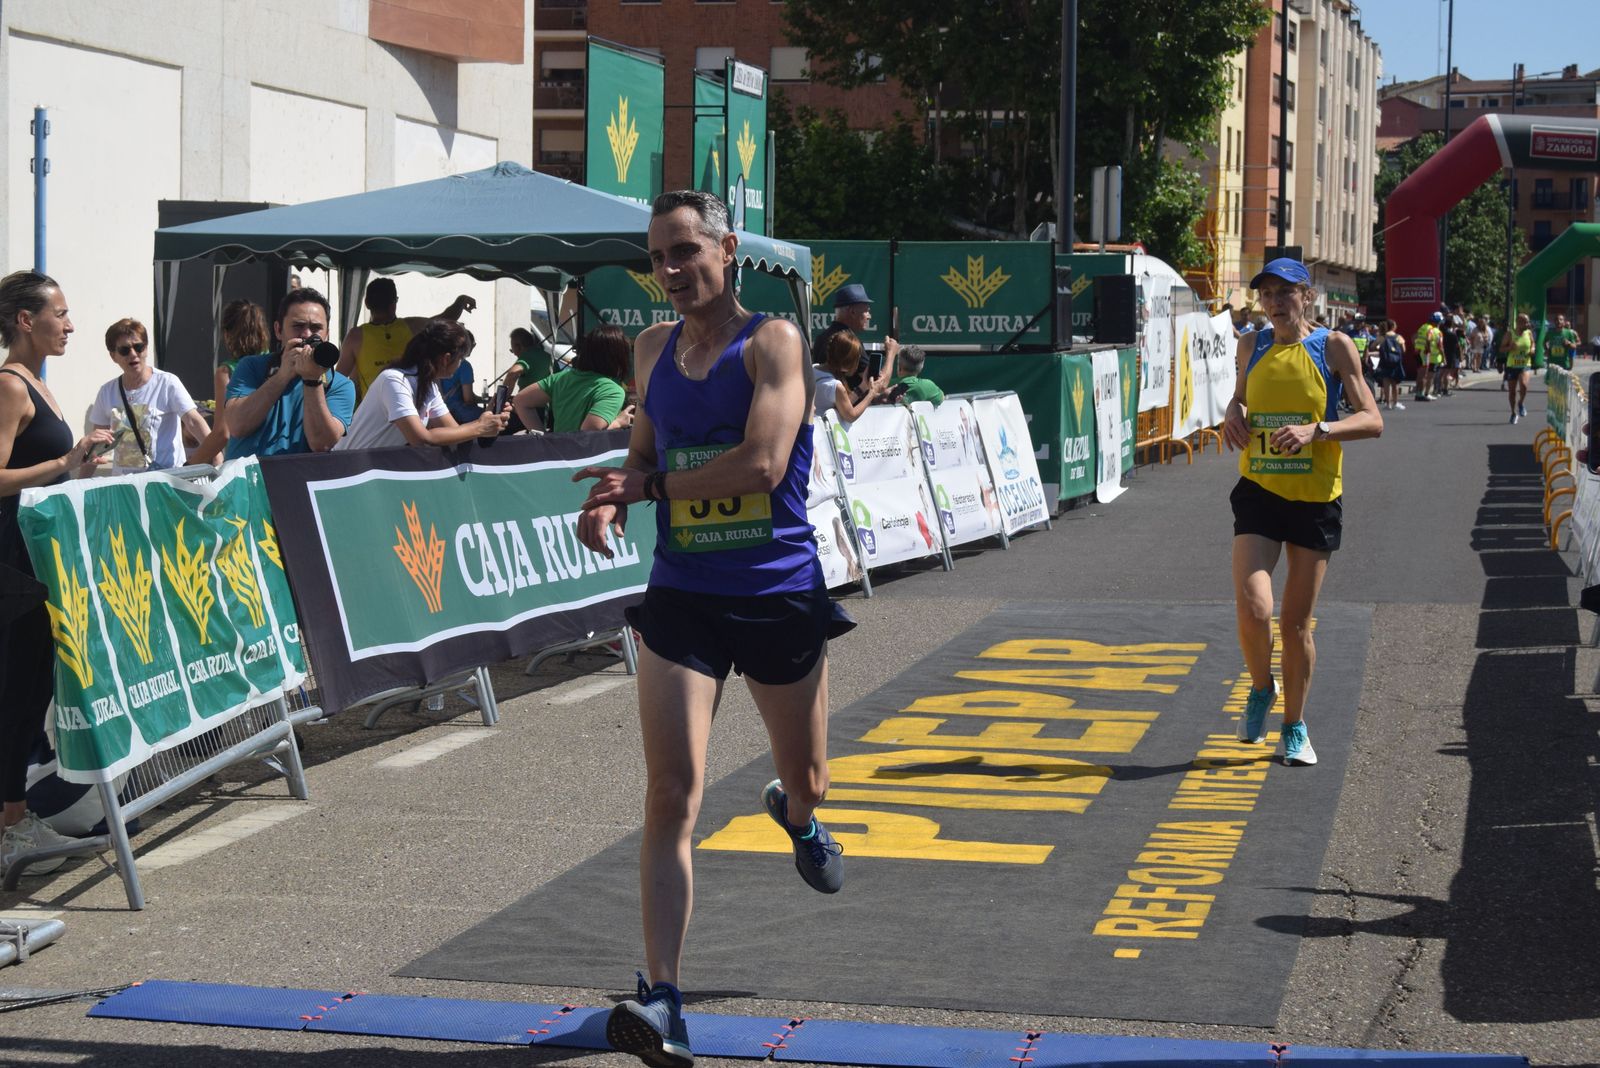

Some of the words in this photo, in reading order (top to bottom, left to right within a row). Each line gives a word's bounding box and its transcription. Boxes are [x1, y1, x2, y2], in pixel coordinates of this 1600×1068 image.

[1546, 143, 1593, 155] ZAMORA
[1400, 290, 1433, 298] ZAMORA
[599, 308, 645, 326] CAJA
[912, 315, 962, 333] CAJA
[968, 315, 1040, 332] RURAL
[997, 475, 1043, 517] OCEANIC
[694, 532, 722, 544] CAJA
[724, 527, 767, 541] RURAL
[455, 521, 542, 598] CAJA
[147, 669, 181, 700] RURAL
[55, 703, 92, 732] AJA
[1093, 820, 1248, 940] REFORMA
